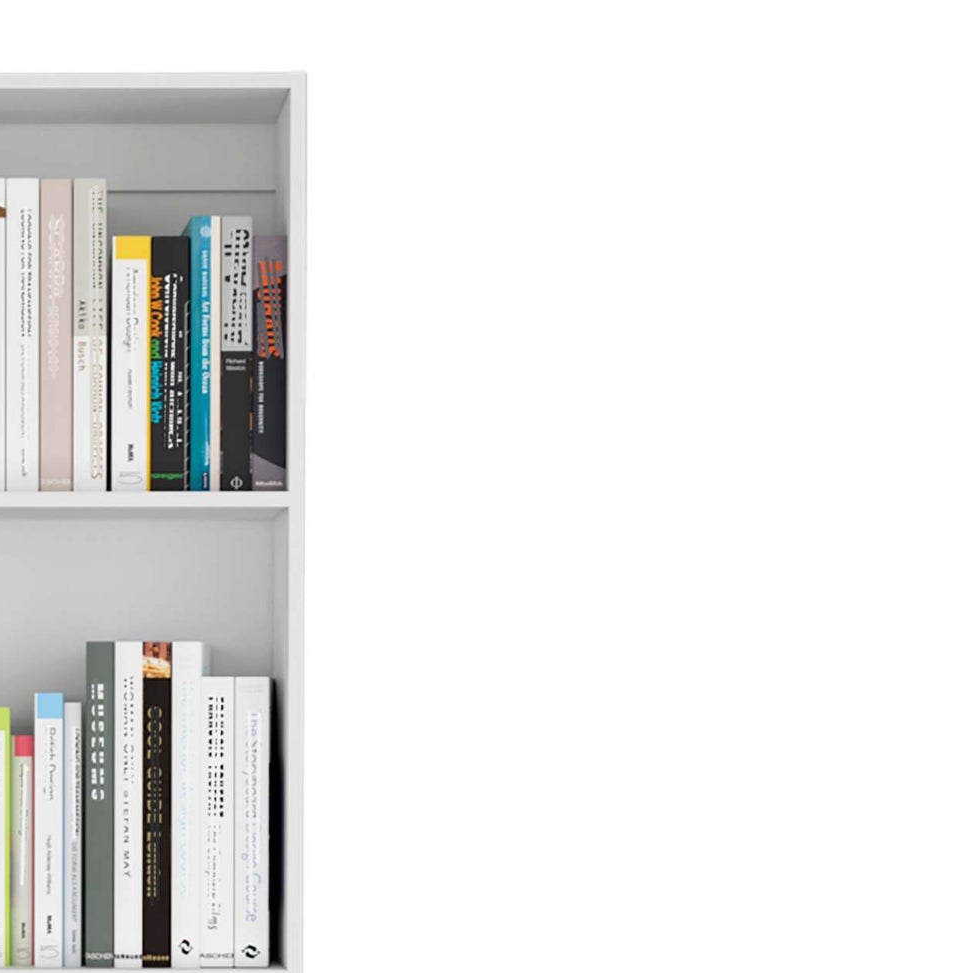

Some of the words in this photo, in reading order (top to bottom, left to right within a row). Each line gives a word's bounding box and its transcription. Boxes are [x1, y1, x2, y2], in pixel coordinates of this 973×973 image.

[78, 300, 87, 330] Akiko
[78, 341, 87, 372] Busch
[151, 338, 162, 359] and
[123, 676, 134, 738] WOMAN
[147, 705, 162, 759] COOL
[91, 683, 105, 802] MUSEUMS
[147, 767, 162, 824] GUIDE
